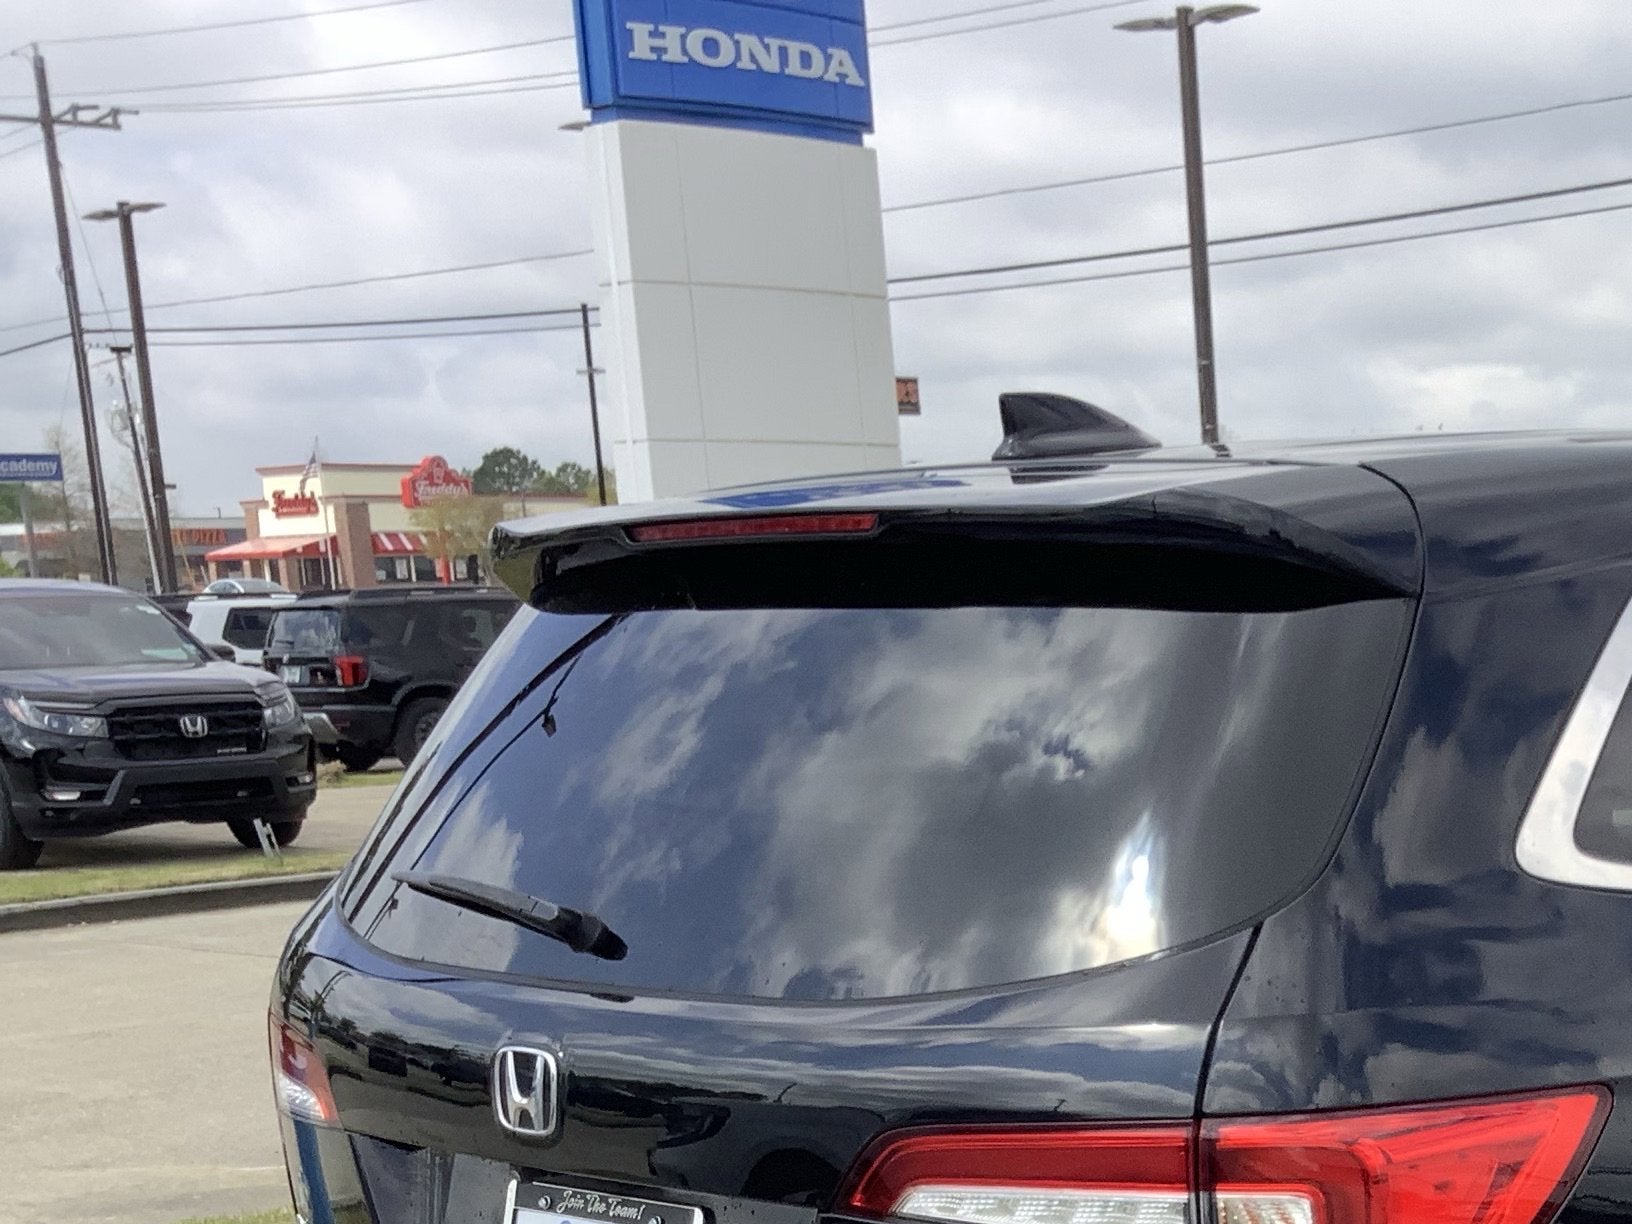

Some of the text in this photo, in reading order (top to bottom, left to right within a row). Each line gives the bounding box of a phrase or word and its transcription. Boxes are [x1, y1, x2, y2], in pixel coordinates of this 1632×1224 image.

[626, 22, 864, 87] HONDA
[0, 458, 57, 476] cademy
[556, 1190, 646, 1220] Join The Team!
